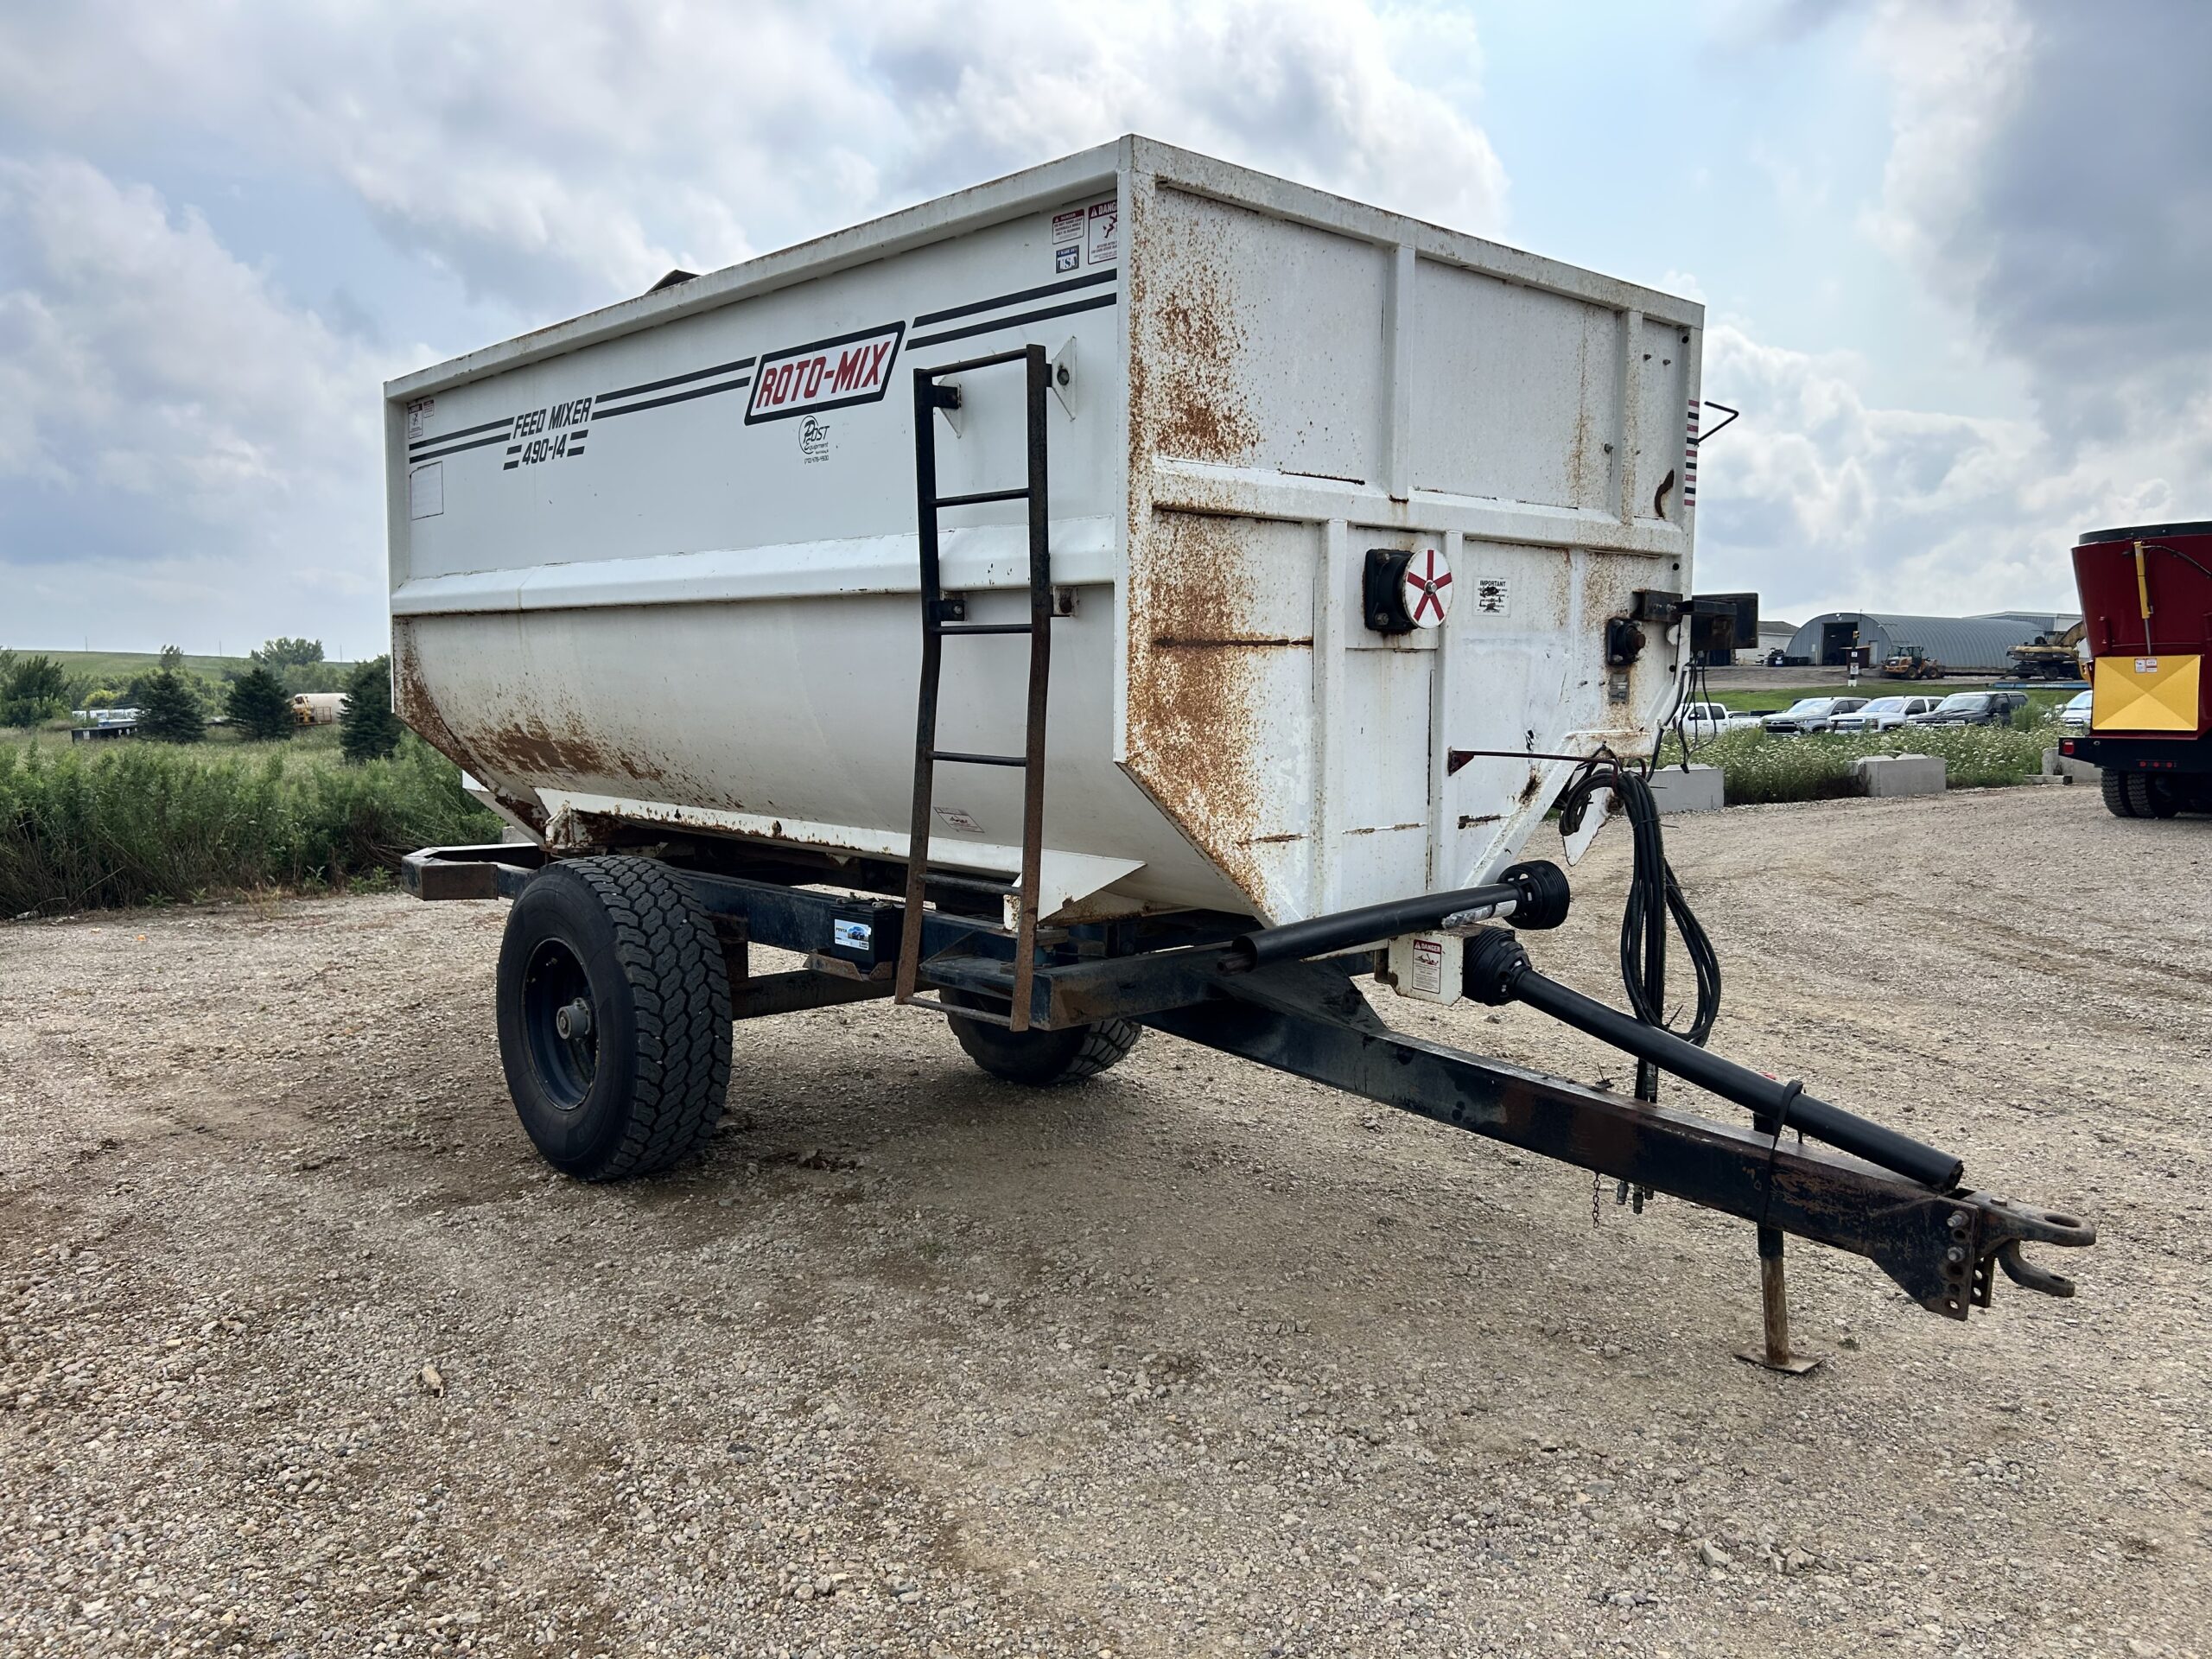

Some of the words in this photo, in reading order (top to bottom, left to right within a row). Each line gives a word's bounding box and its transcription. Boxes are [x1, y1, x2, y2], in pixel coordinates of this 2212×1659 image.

[1098, 201, 1117, 215] DANG
[1058, 255, 1077, 270] USA
[755, 341, 891, 409] ROTO-MIX
[512, 409, 546, 439] FEED
[548, 397, 592, 430] MIXER
[522, 434, 567, 465] 490-14
[1421, 943, 1440, 952] DANGER
